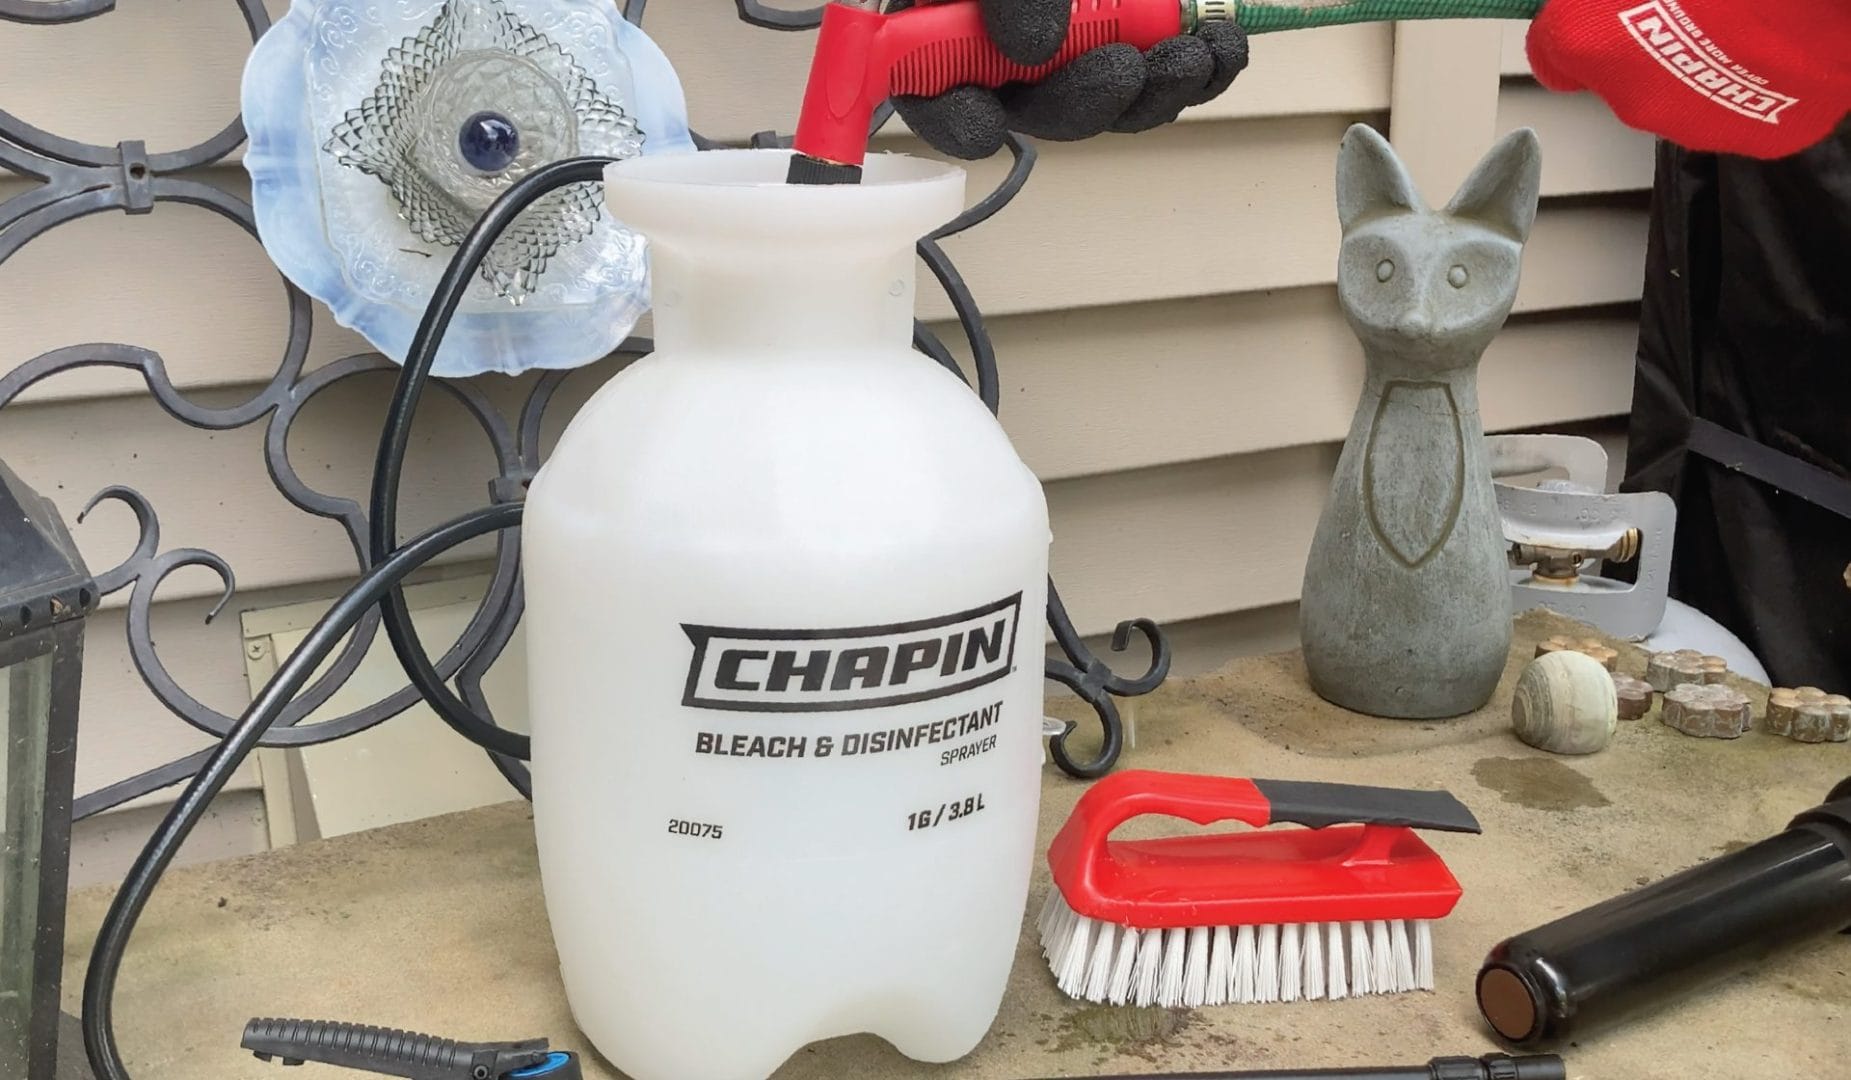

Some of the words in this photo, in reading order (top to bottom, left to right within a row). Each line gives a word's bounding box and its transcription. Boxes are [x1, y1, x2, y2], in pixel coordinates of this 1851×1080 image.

[1637, 17, 1777, 112] CHAPIN
[1699, 38, 1733, 64] MORE
[714, 618, 1006, 692] CHAPIN
[695, 732, 807, 758] BLEACH
[814, 736, 834, 758] &
[841, 700, 1004, 756] DISINFECTANT
[941, 734, 997, 766] SPRAYER
[668, 818, 723, 839] 20075
